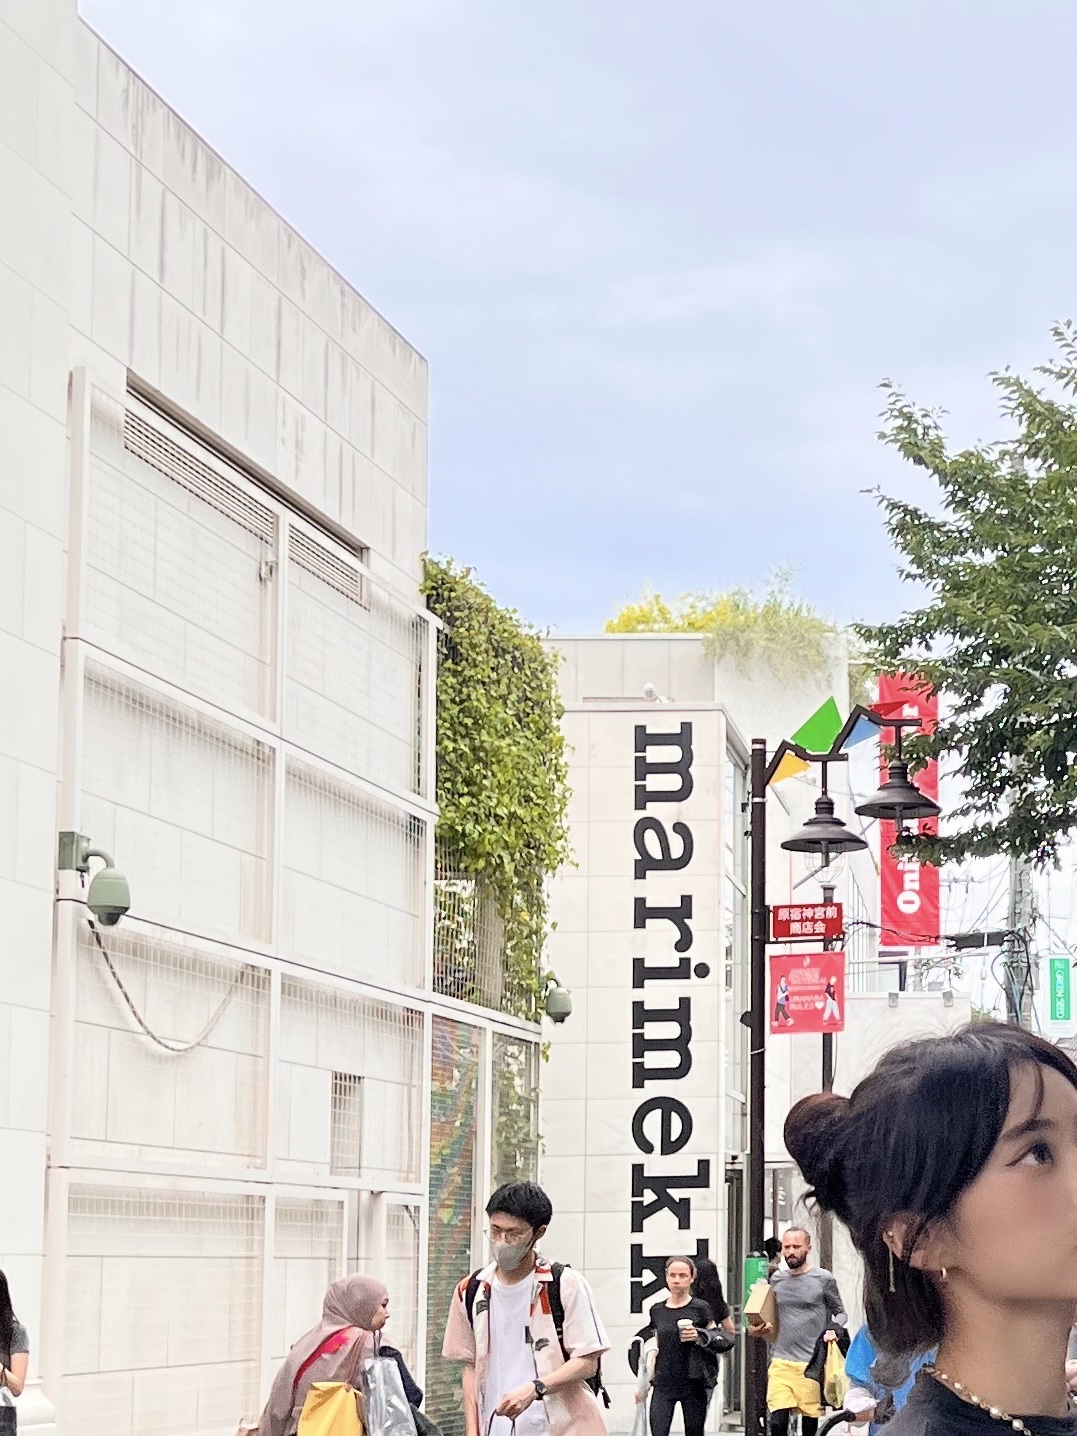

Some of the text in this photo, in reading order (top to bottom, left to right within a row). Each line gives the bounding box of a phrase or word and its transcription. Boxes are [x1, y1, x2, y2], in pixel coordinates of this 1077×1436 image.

[777, 906, 838, 922] 原宿神宮前
[789, 921, 827, 935] 商店会
[628, 721, 710, 1377] marimekk
